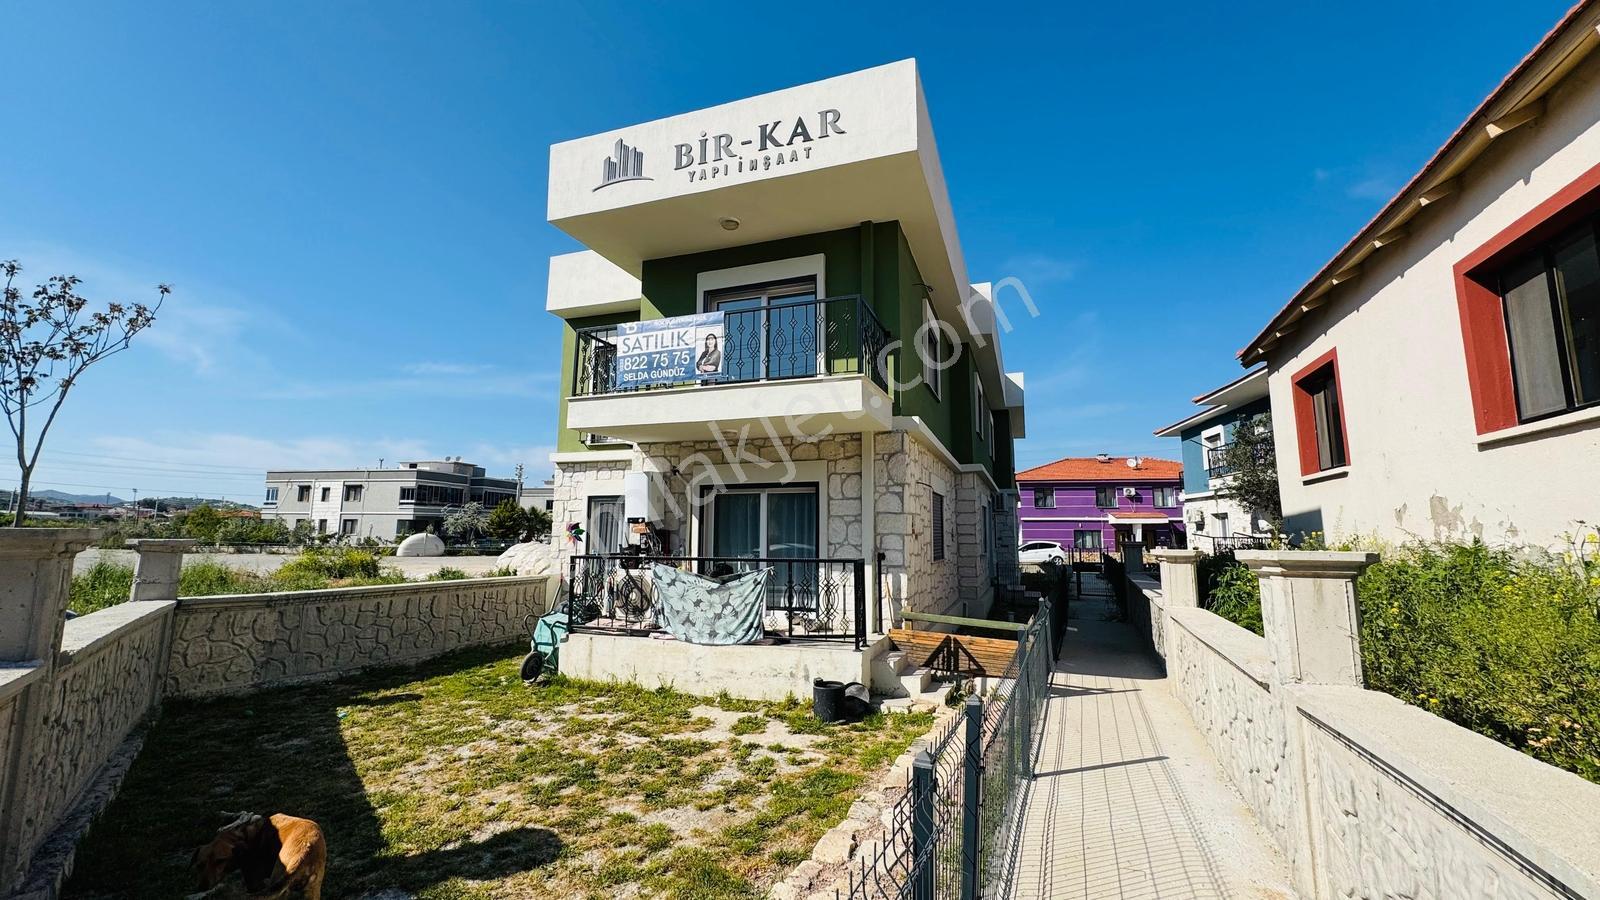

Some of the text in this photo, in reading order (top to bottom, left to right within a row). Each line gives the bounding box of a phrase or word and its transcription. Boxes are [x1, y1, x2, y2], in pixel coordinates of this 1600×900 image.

[674, 108, 847, 171] BİR-KAR
[688, 164, 728, 183] YAPI
[622, 331, 689, 354] SATILIK
[624, 356, 648, 371] 822
[653, 354, 668, 368] 75
[673, 350, 690, 365] 75
[623, 367, 686, 382] SELDA GÜNDÜZ
